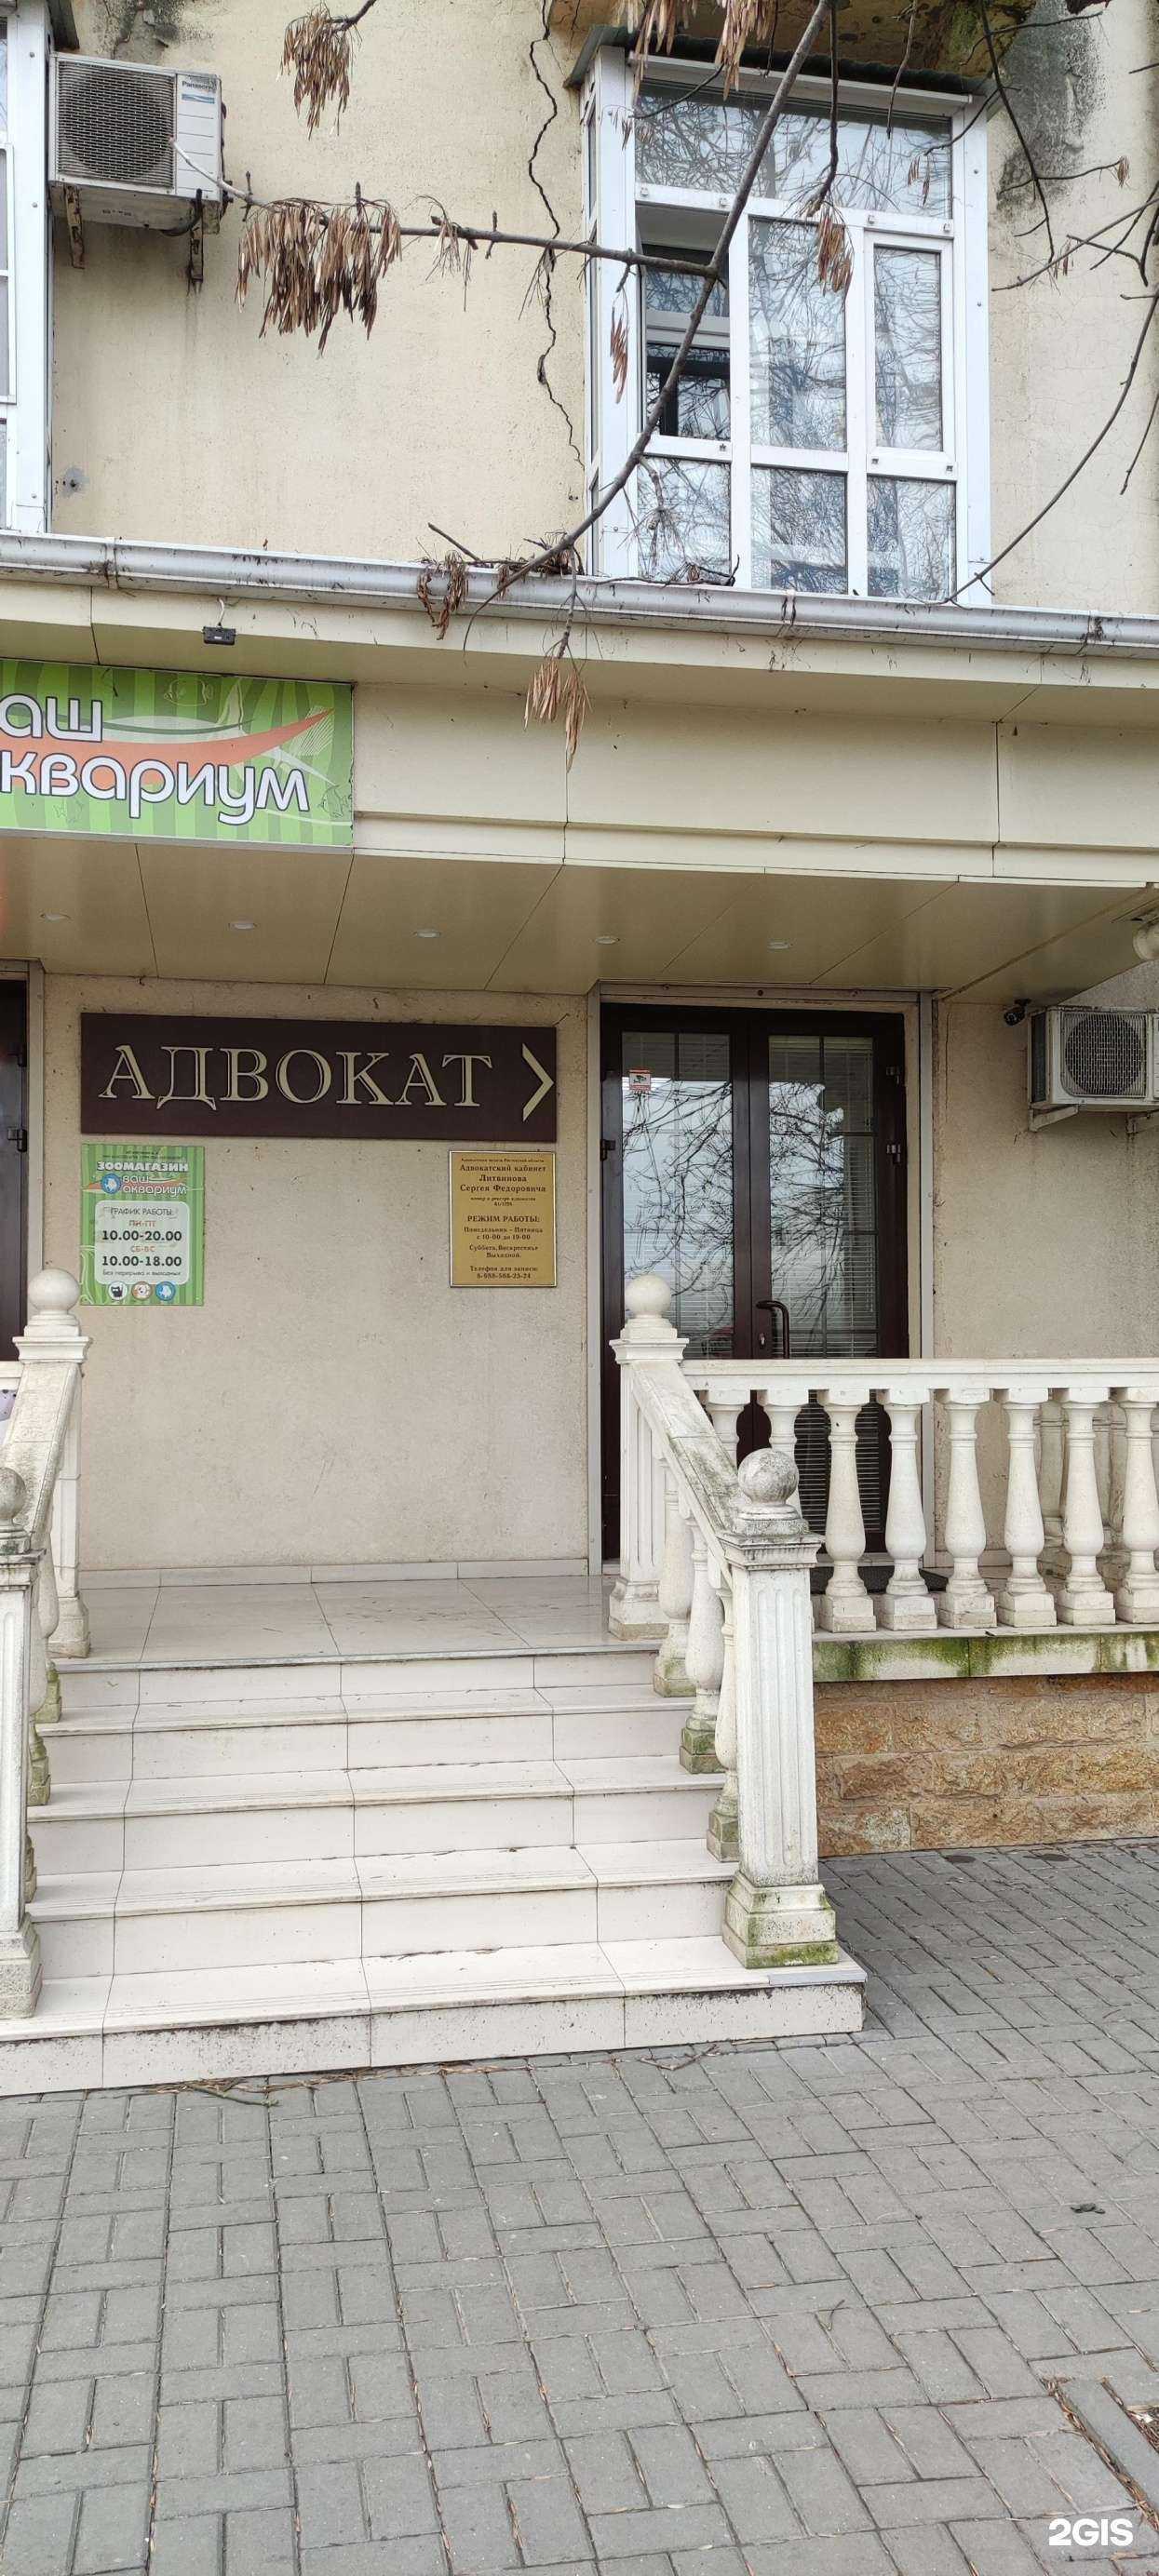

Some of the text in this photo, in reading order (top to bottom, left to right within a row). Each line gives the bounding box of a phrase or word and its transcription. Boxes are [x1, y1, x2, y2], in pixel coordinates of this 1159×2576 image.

[0, 749, 310, 825] квариум
[98, 1044, 493, 1111] АДВОКАТ
[97, 1161, 189, 1173] ЗООМАГАЗИН
[460, 1164, 546, 1173] Адвокатский кабинет
[123, 1174, 149, 1184] ваш
[123, 1185, 187, 1197] аквариум
[460, 1184, 546, 1194] Сергея Федоровича
[101, 1230, 182, 1241] 10.00-20.00
[101, 1255, 182, 1267] 10.00-18.00
